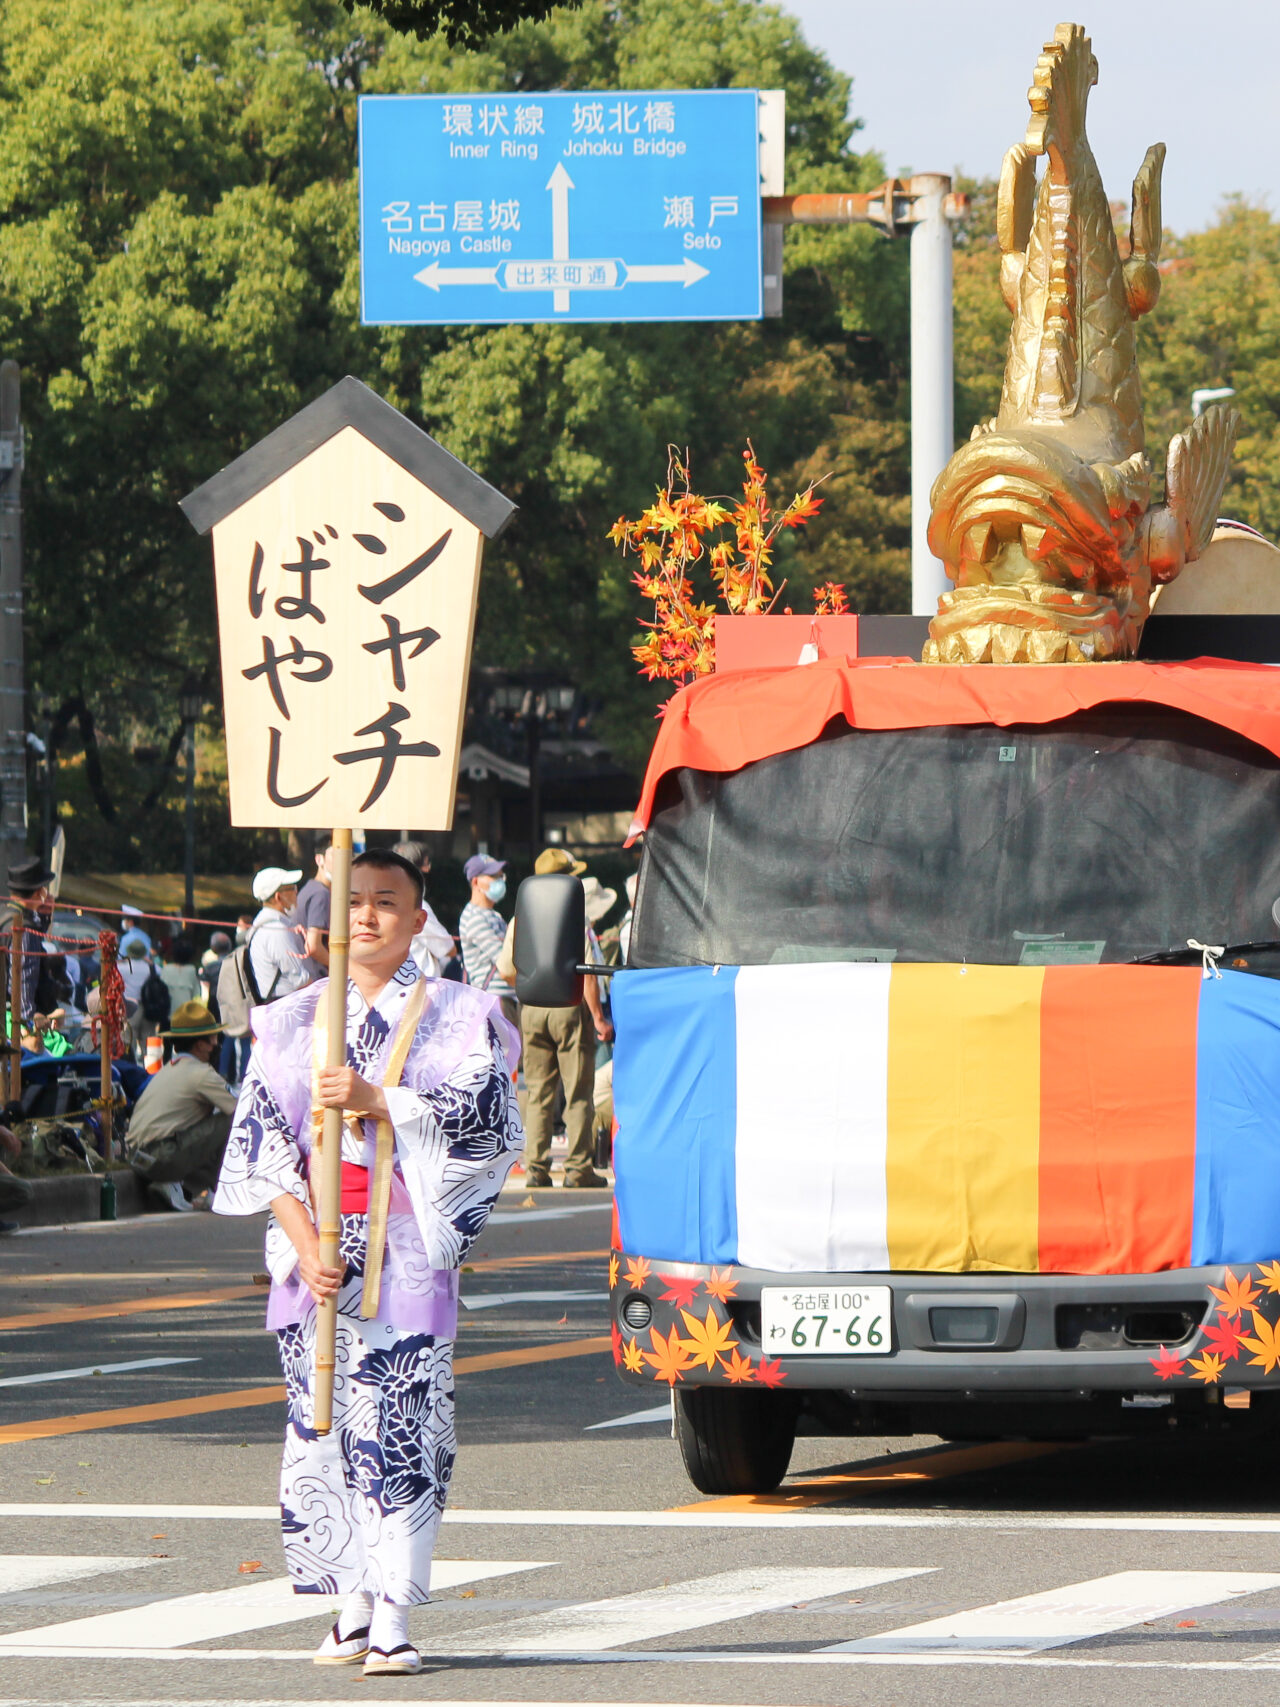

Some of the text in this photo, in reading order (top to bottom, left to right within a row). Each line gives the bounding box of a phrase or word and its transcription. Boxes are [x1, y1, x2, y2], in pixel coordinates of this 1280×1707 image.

[442, 101, 676, 136] 環状線 城北橋
[449, 138, 687, 160] Inner Ring Johoku Bridge
[380, 198, 522, 234] 名古屋城
[662, 195, 740, 229] 瀬戸
[388, 235, 513, 257] Nagoya Castle
[683, 232, 722, 250] Seto
[515, 264, 608, 286] 出来町通
[241, 523, 339, 808] ばやし
[332, 502, 453, 814] シャチ
[769, 1315, 883, 1348] わ 67-66
